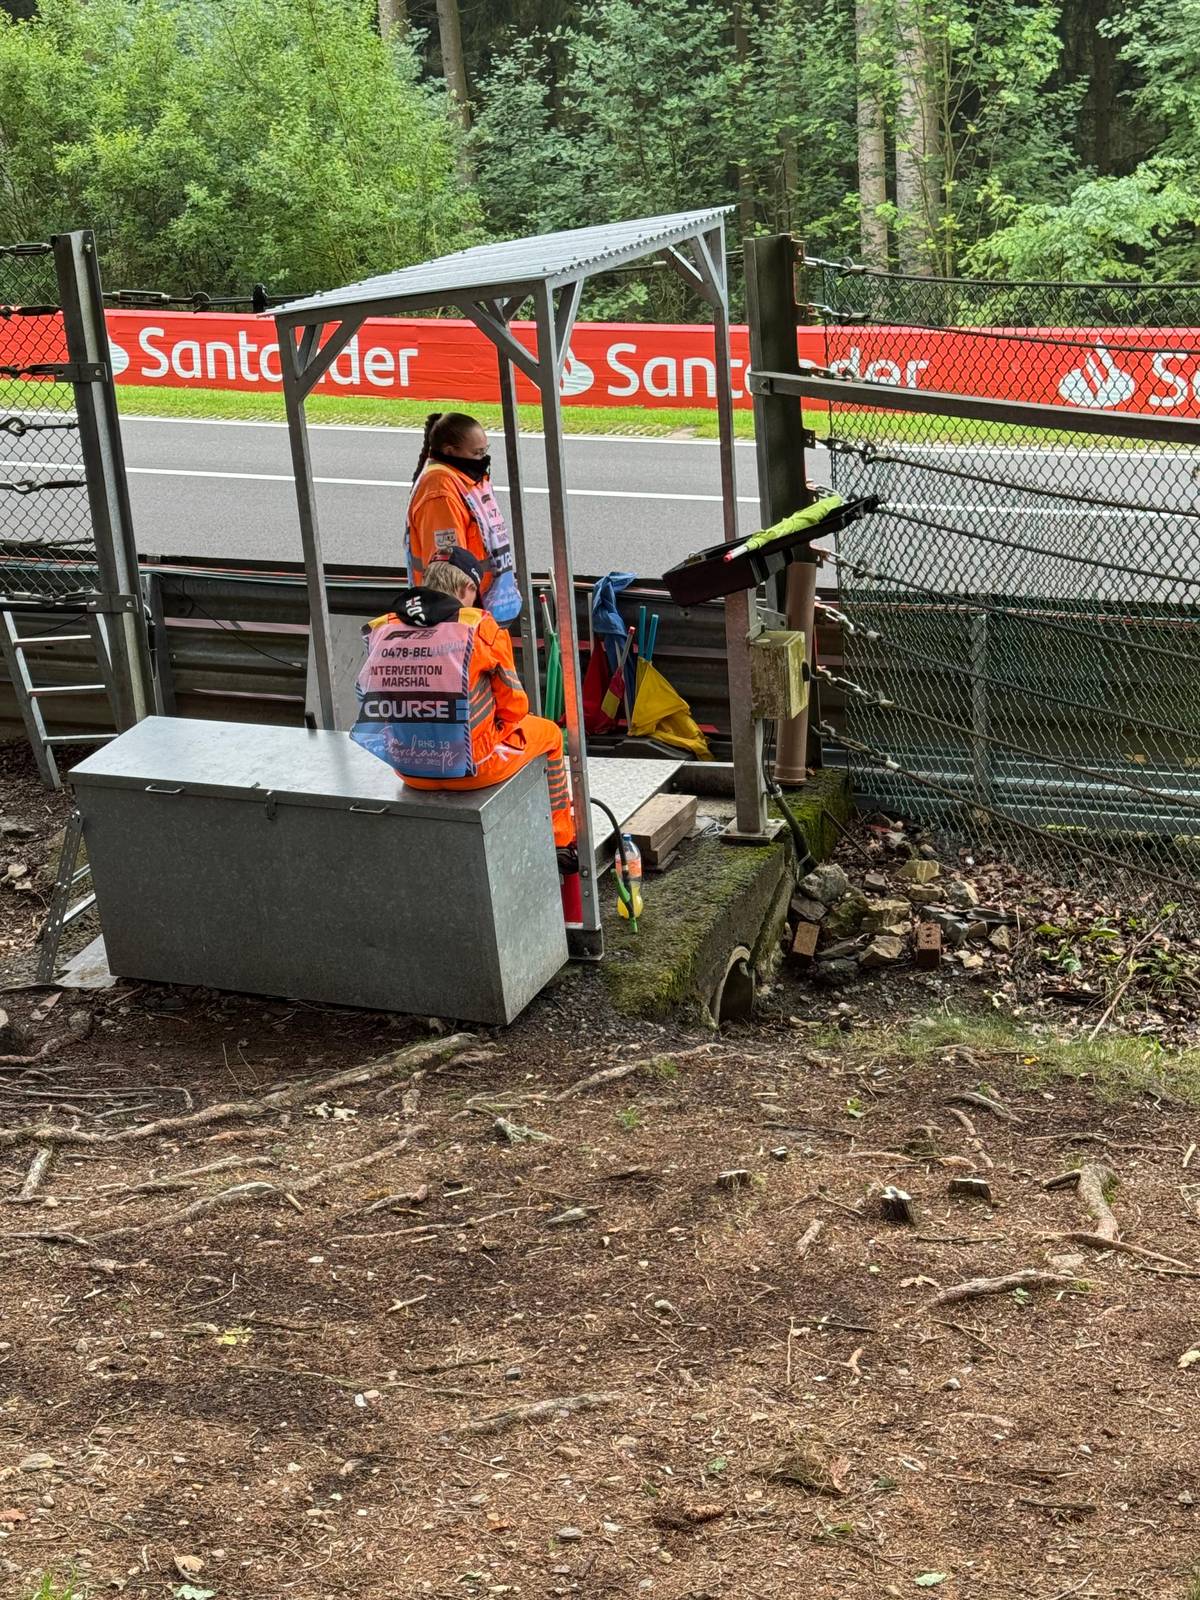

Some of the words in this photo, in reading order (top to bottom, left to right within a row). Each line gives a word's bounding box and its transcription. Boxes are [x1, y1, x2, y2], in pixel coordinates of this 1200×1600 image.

[381, 647, 433, 658] 0478-BEL
[381, 677, 430, 687] MARSHAL
[364, 700, 450, 719] COURSE
[439, 740, 450, 750] 13
